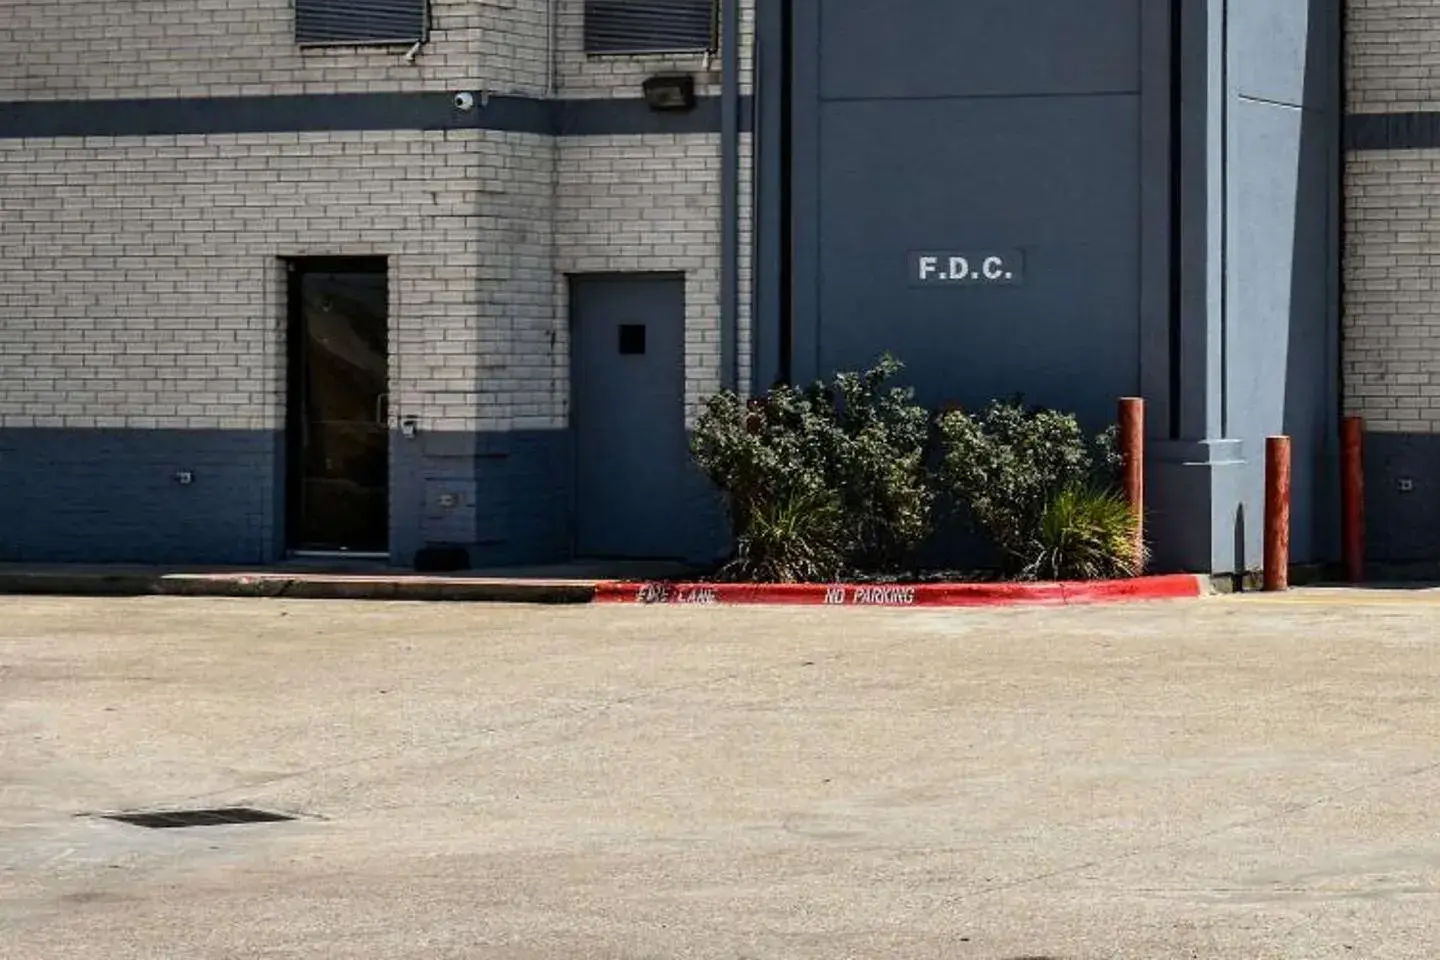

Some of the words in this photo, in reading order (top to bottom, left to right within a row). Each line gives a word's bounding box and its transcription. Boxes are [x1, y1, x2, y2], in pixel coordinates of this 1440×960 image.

[919, 256, 1013, 280] F.D.C.
[824, 586, 845, 604] NO
[853, 585, 915, 604] PARKING
